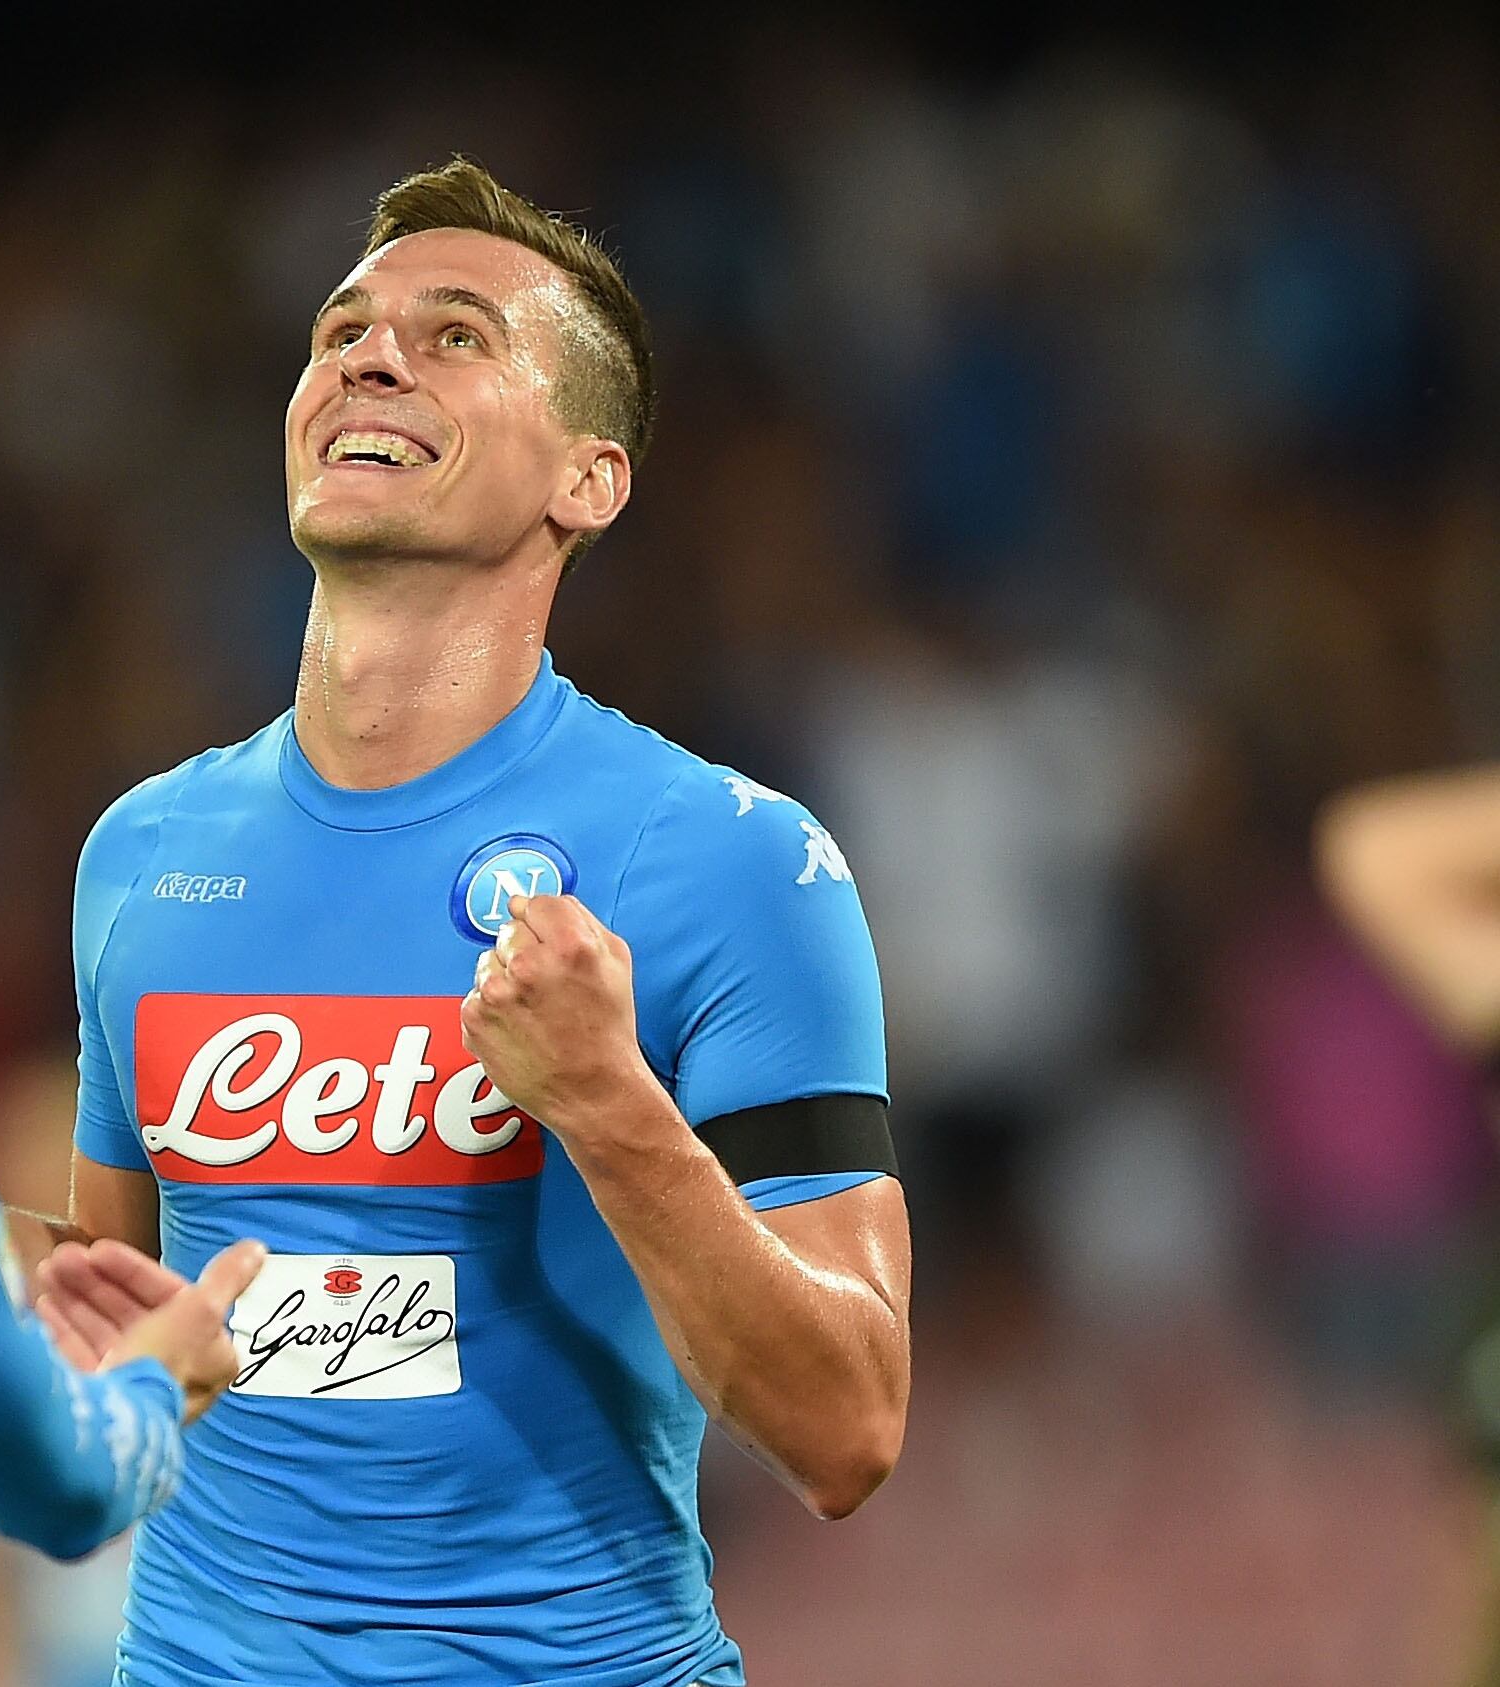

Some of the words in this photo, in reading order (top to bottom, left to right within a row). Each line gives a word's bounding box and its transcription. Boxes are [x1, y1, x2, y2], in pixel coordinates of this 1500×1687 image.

[153, 872, 246, 902] Kappa
[482, 867, 546, 921] N
[141, 1012, 522, 1166] Lete
[232, 1274, 453, 1394] Garofalo
